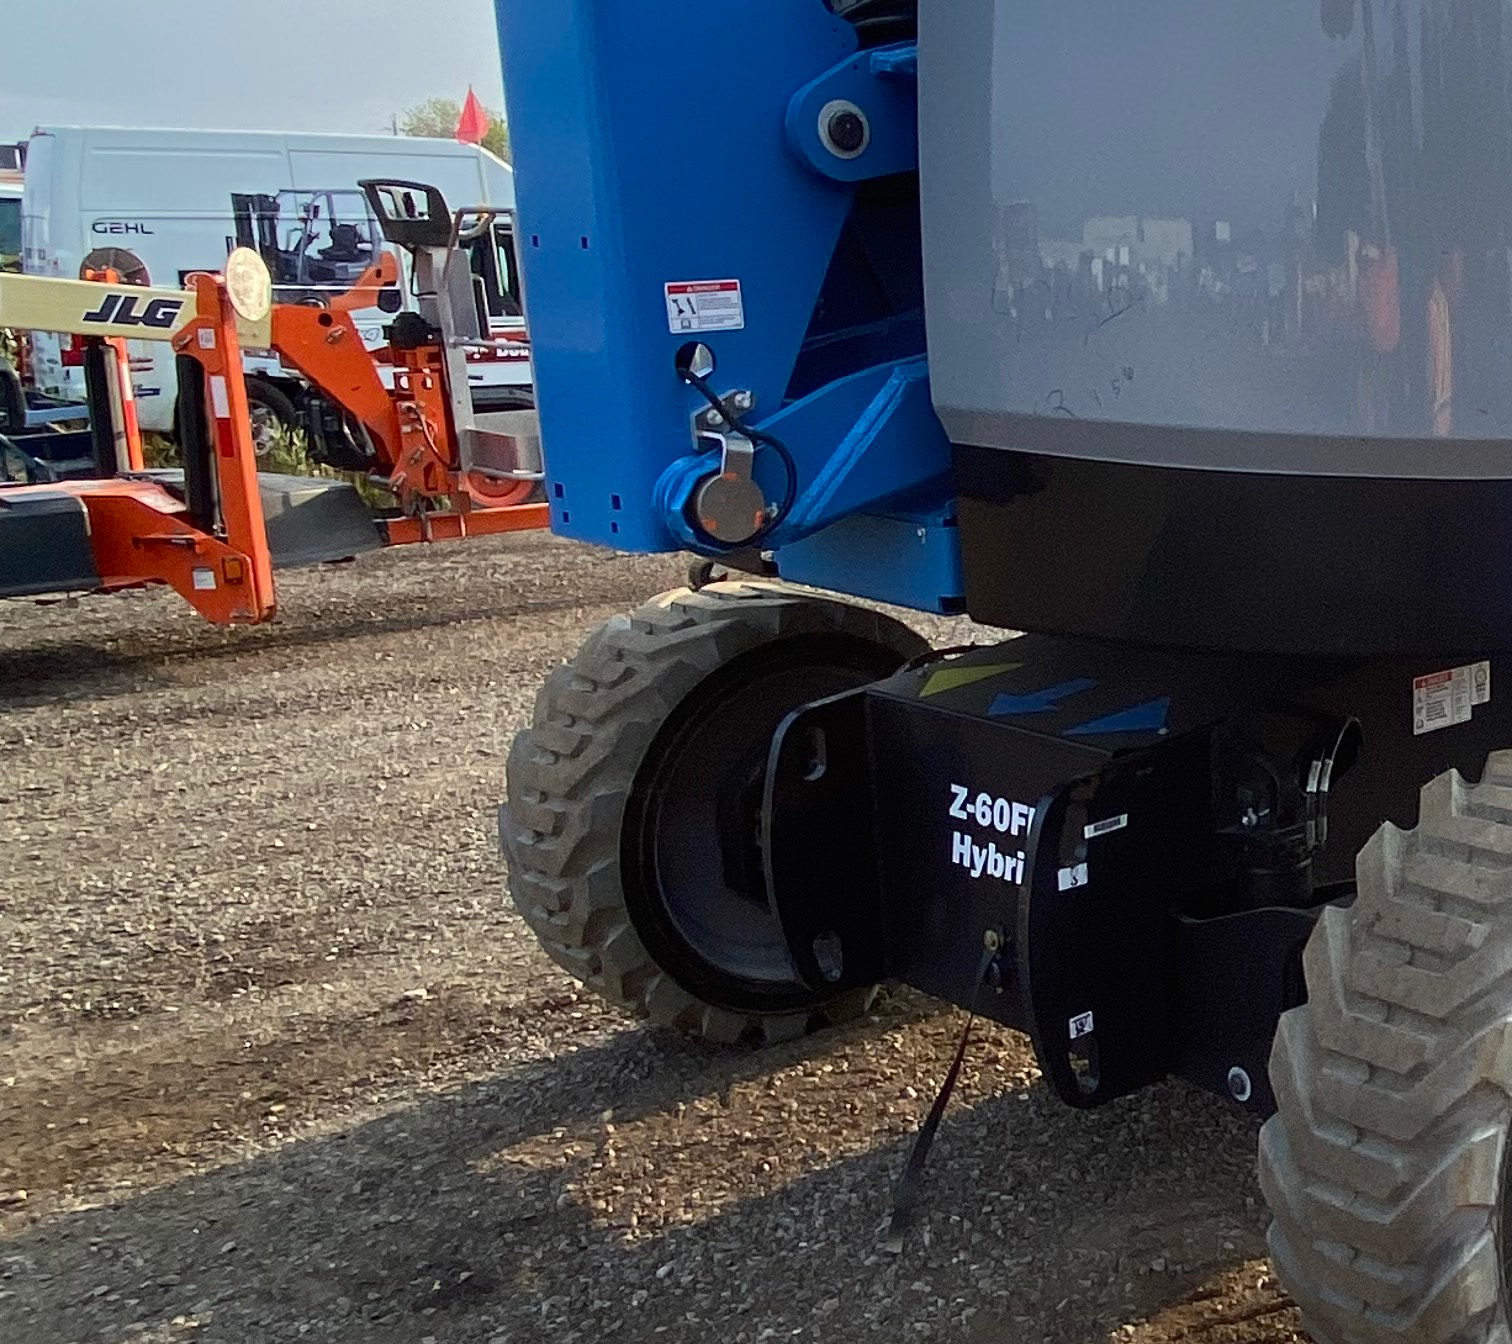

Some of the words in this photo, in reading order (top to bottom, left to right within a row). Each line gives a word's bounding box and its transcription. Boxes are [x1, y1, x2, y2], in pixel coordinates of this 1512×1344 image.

[92, 222, 155, 235] GEHL
[82, 294, 184, 328] JLG
[952, 831, 1026, 885] Hybri
